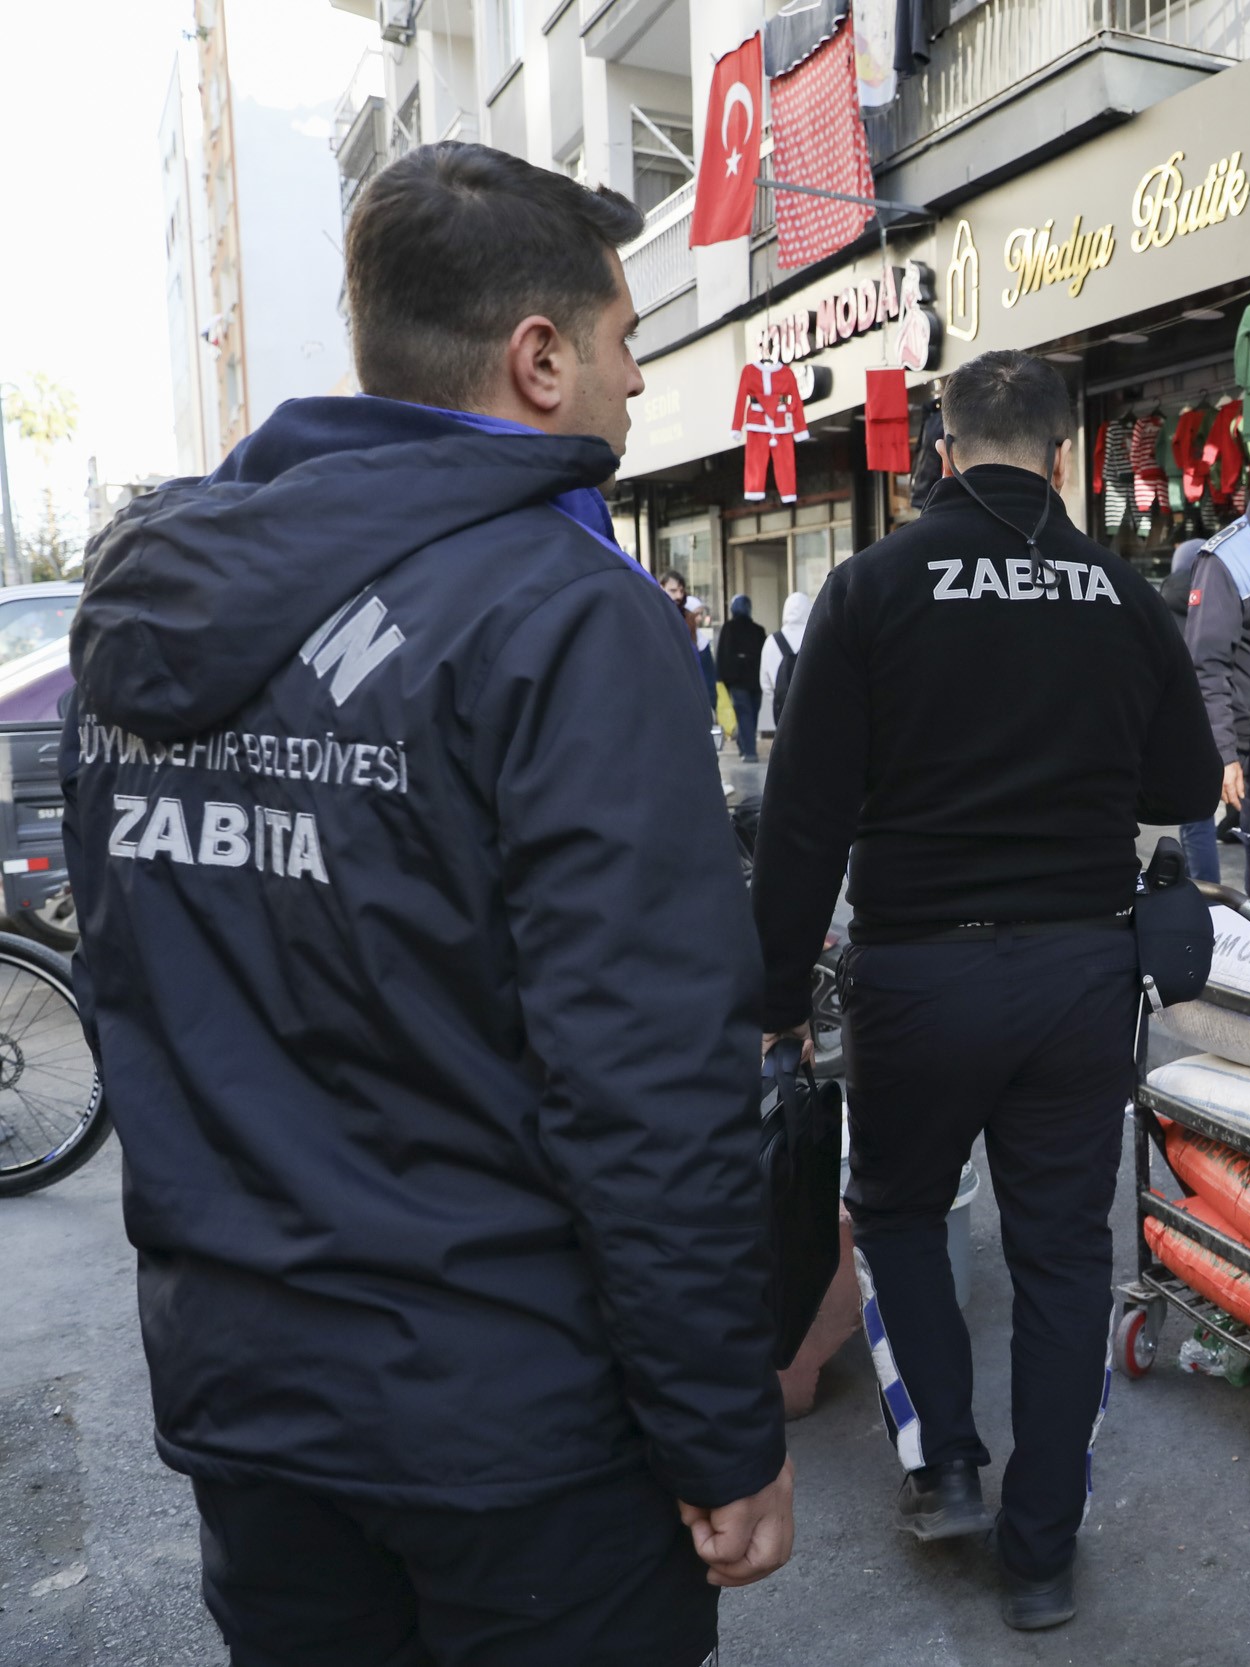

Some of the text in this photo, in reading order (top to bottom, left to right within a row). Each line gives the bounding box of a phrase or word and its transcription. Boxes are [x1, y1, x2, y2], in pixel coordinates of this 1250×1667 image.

[1001, 151, 1250, 309] Medya Butik
[815, 264, 899, 349] MODA
[927, 558, 1121, 605] ZABITA
[243, 732, 407, 793] BELEDİYESİ
[108, 795, 330, 884] ZABITA
